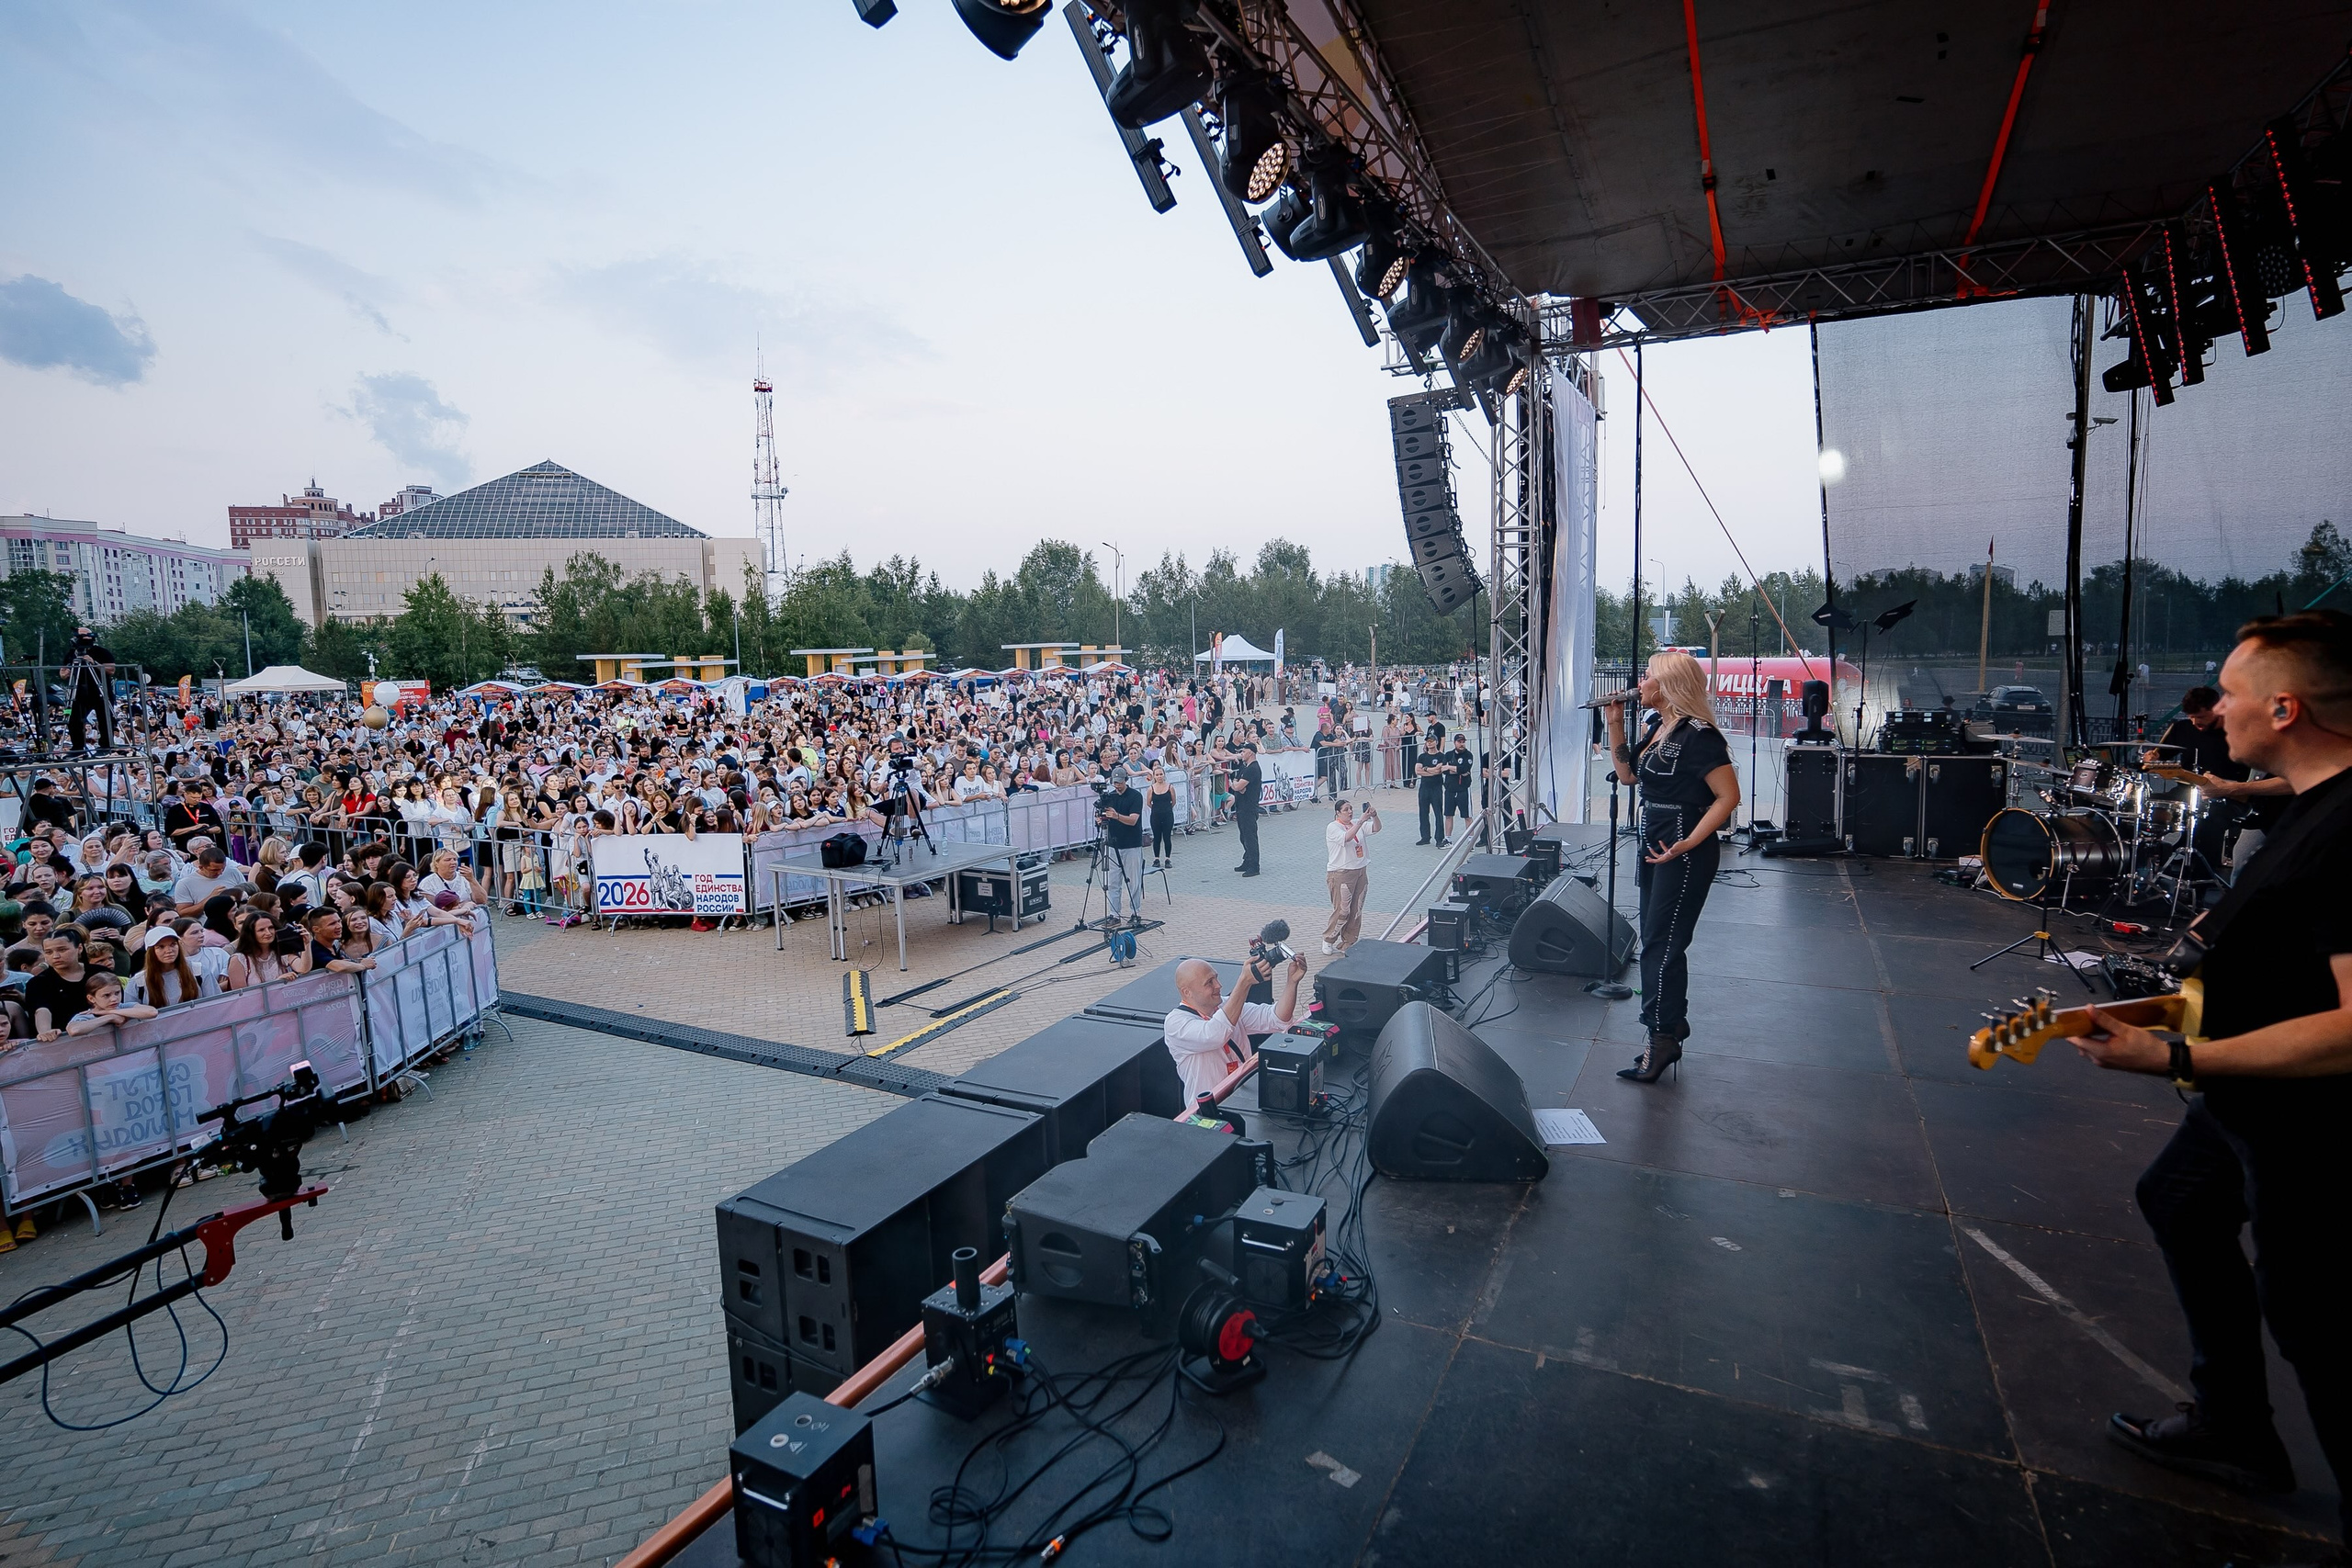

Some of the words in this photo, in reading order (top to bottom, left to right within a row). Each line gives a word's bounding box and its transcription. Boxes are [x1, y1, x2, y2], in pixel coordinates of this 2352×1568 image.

[254, 557, 306, 567] РОССЕТИ
[695, 874, 714, 884] ГОД
[695, 884, 744, 893] ЕДИНСТВА
[598, 881, 650, 907] 2026
[696, 894, 740, 903] НАРОДОВ
[697, 904, 735, 913] РОССИИ
